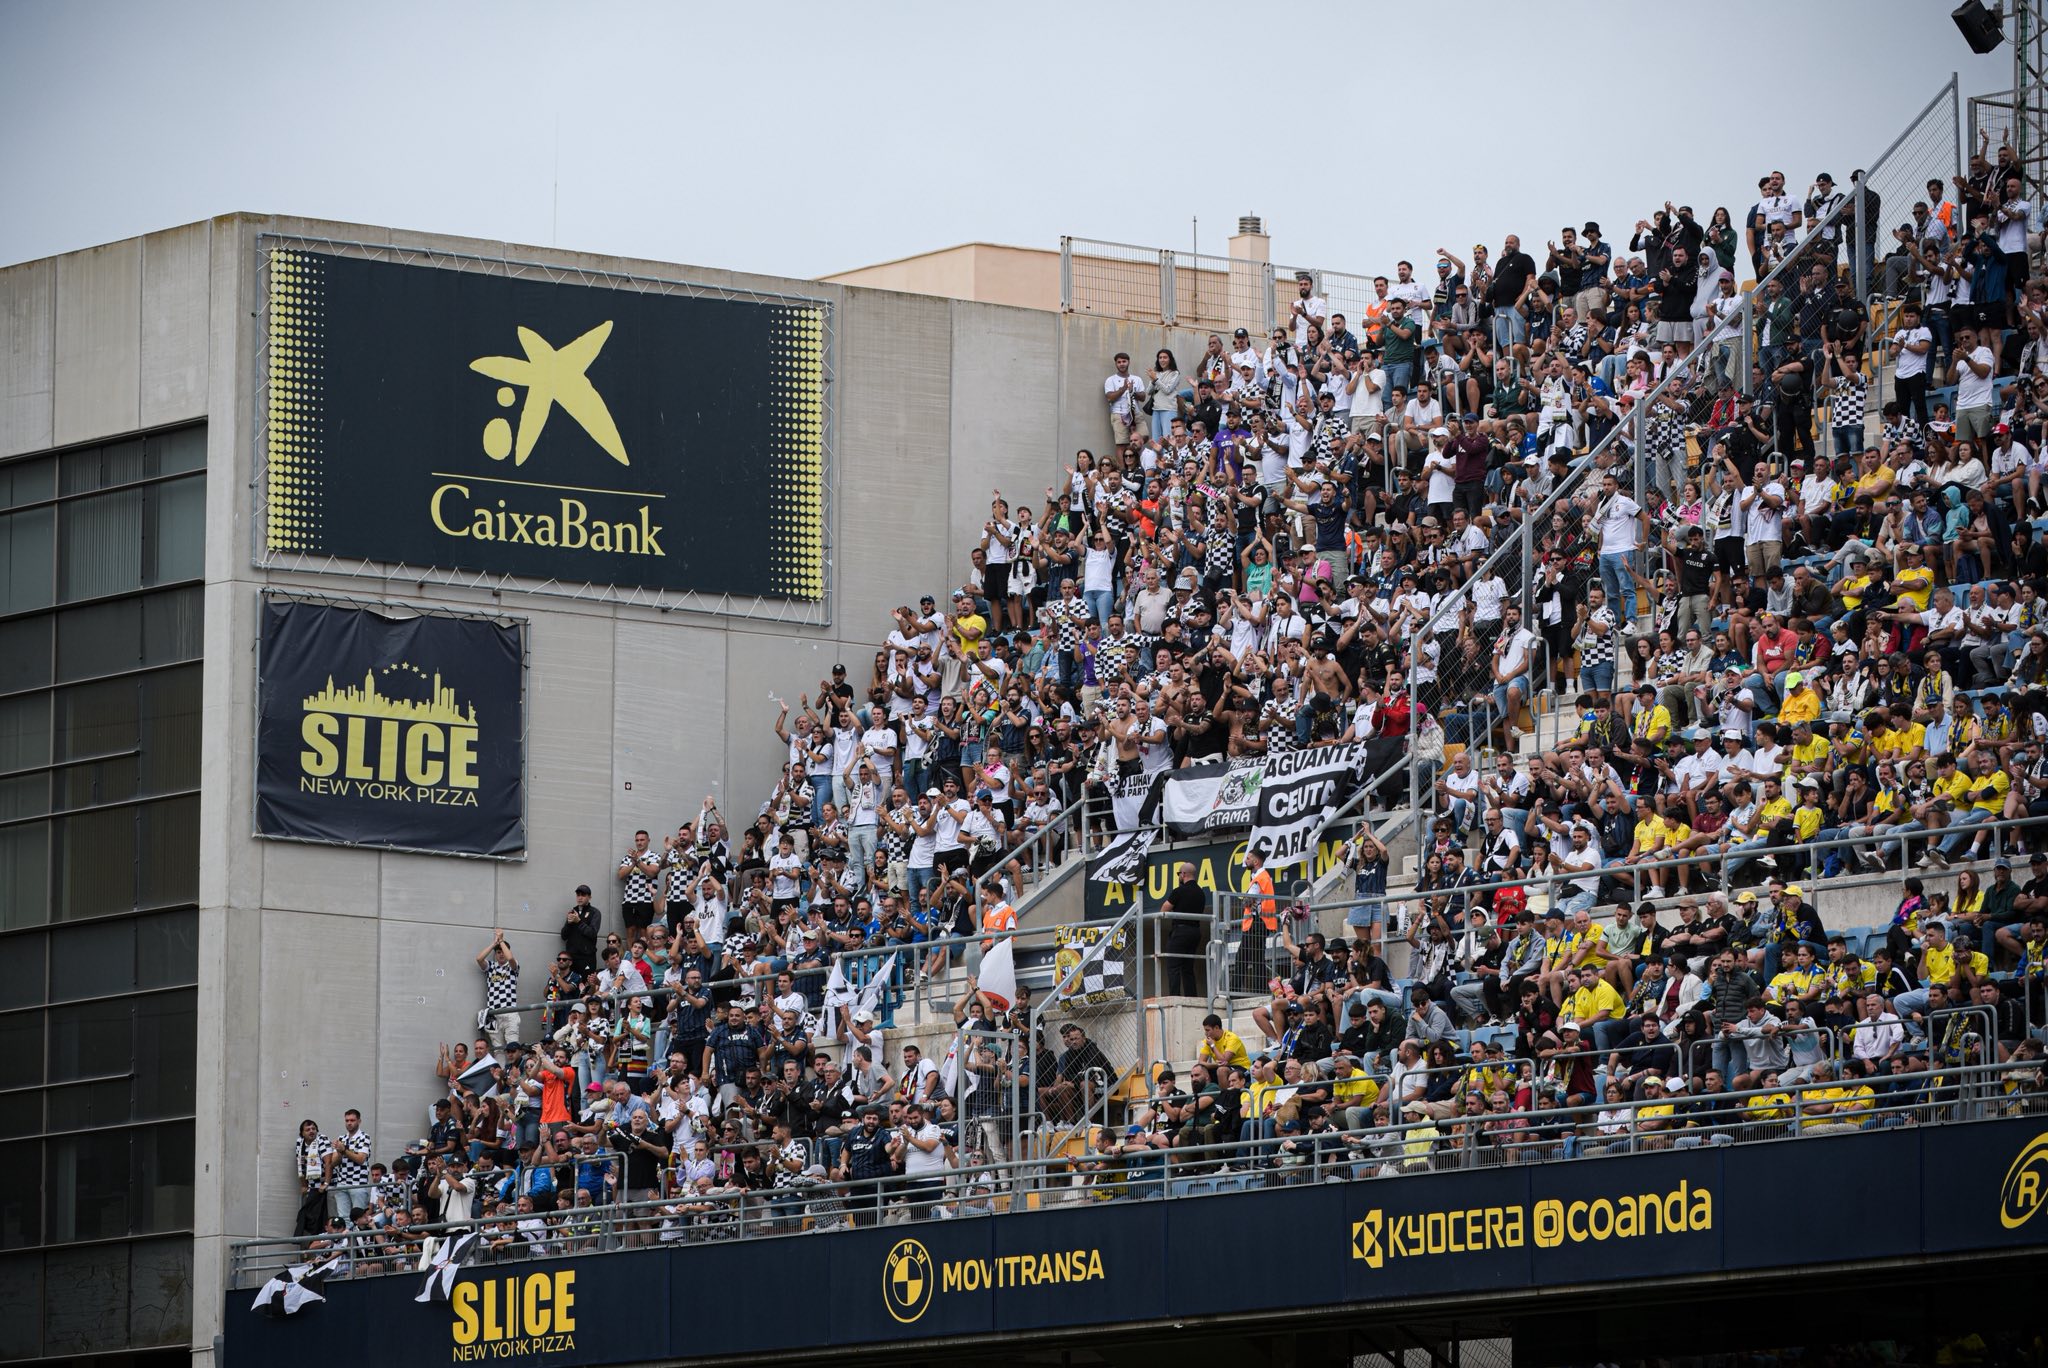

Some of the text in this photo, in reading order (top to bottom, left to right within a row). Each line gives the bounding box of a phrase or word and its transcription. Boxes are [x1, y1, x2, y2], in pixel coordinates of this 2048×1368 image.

[430, 484, 666, 556] CaixaBank
[301, 713, 479, 788] SLICE
[1264, 744, 1361, 778] AGUANTE
[301, 777, 478, 807] NEW YORK PIZZA
[1389, 1180, 1712, 1258] KYOCERA coanda
[890, 1244, 926, 1267] BMW
[943, 1249, 1104, 1293] MOVITRANSA
[453, 1270, 575, 1344] SLICE
[453, 1335, 575, 1362] NEW YORK PIZZA
